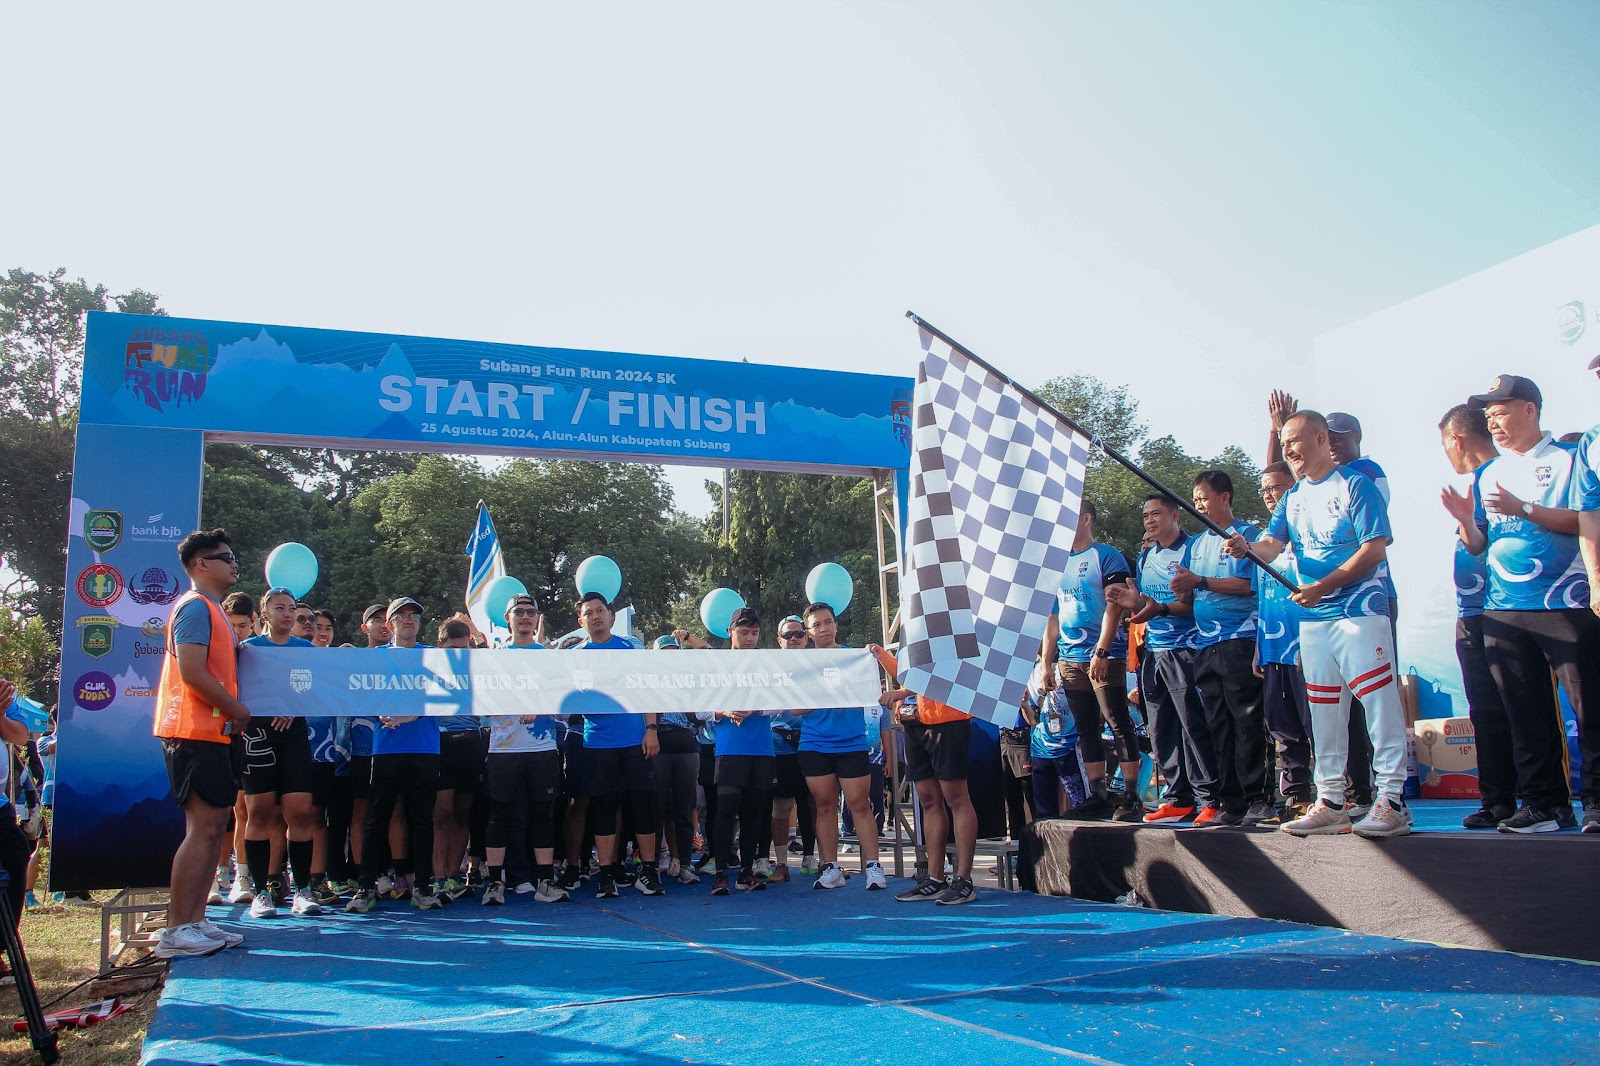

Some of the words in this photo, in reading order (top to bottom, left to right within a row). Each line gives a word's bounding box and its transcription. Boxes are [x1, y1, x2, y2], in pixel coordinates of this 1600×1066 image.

[128, 327, 208, 344] SUBANG
[126, 342, 208, 373] FUN
[480, 359, 542, 377] Subang
[547, 364, 576, 378] Fun
[580, 367, 611, 380] Run
[615, 369, 653, 383] 2024
[657, 372, 676, 385] 5K
[125, 369, 207, 414] RUN
[378, 374, 555, 421] START
[570, 388, 591, 425] /
[608, 391, 766, 435] FINISH
[421, 422, 437, 433] 25
[441, 424, 498, 437] Agustus
[501, 427, 539, 441] 2024,
[542, 430, 608, 444] Alun-Alun
[611, 434, 680, 448] Kabupaten
[684, 438, 731, 452] Subang
[131, 524, 159, 536] bank
[161, 525, 182, 538] bjb
[1500, 522, 1523, 534] 2024
[134, 641, 165, 658] Suban
[350, 673, 427, 690] SUBANG
[432, 673, 469, 690] FUN
[473, 673, 512, 690] RUN
[515, 673, 540, 690] 5K
[625, 673, 696, 689] SUBANG
[699, 673, 733, 688] FUN
[736, 672, 770, 688] RUN
[772, 672, 793, 688] 5K
[79, 689, 111, 701] TODAY
